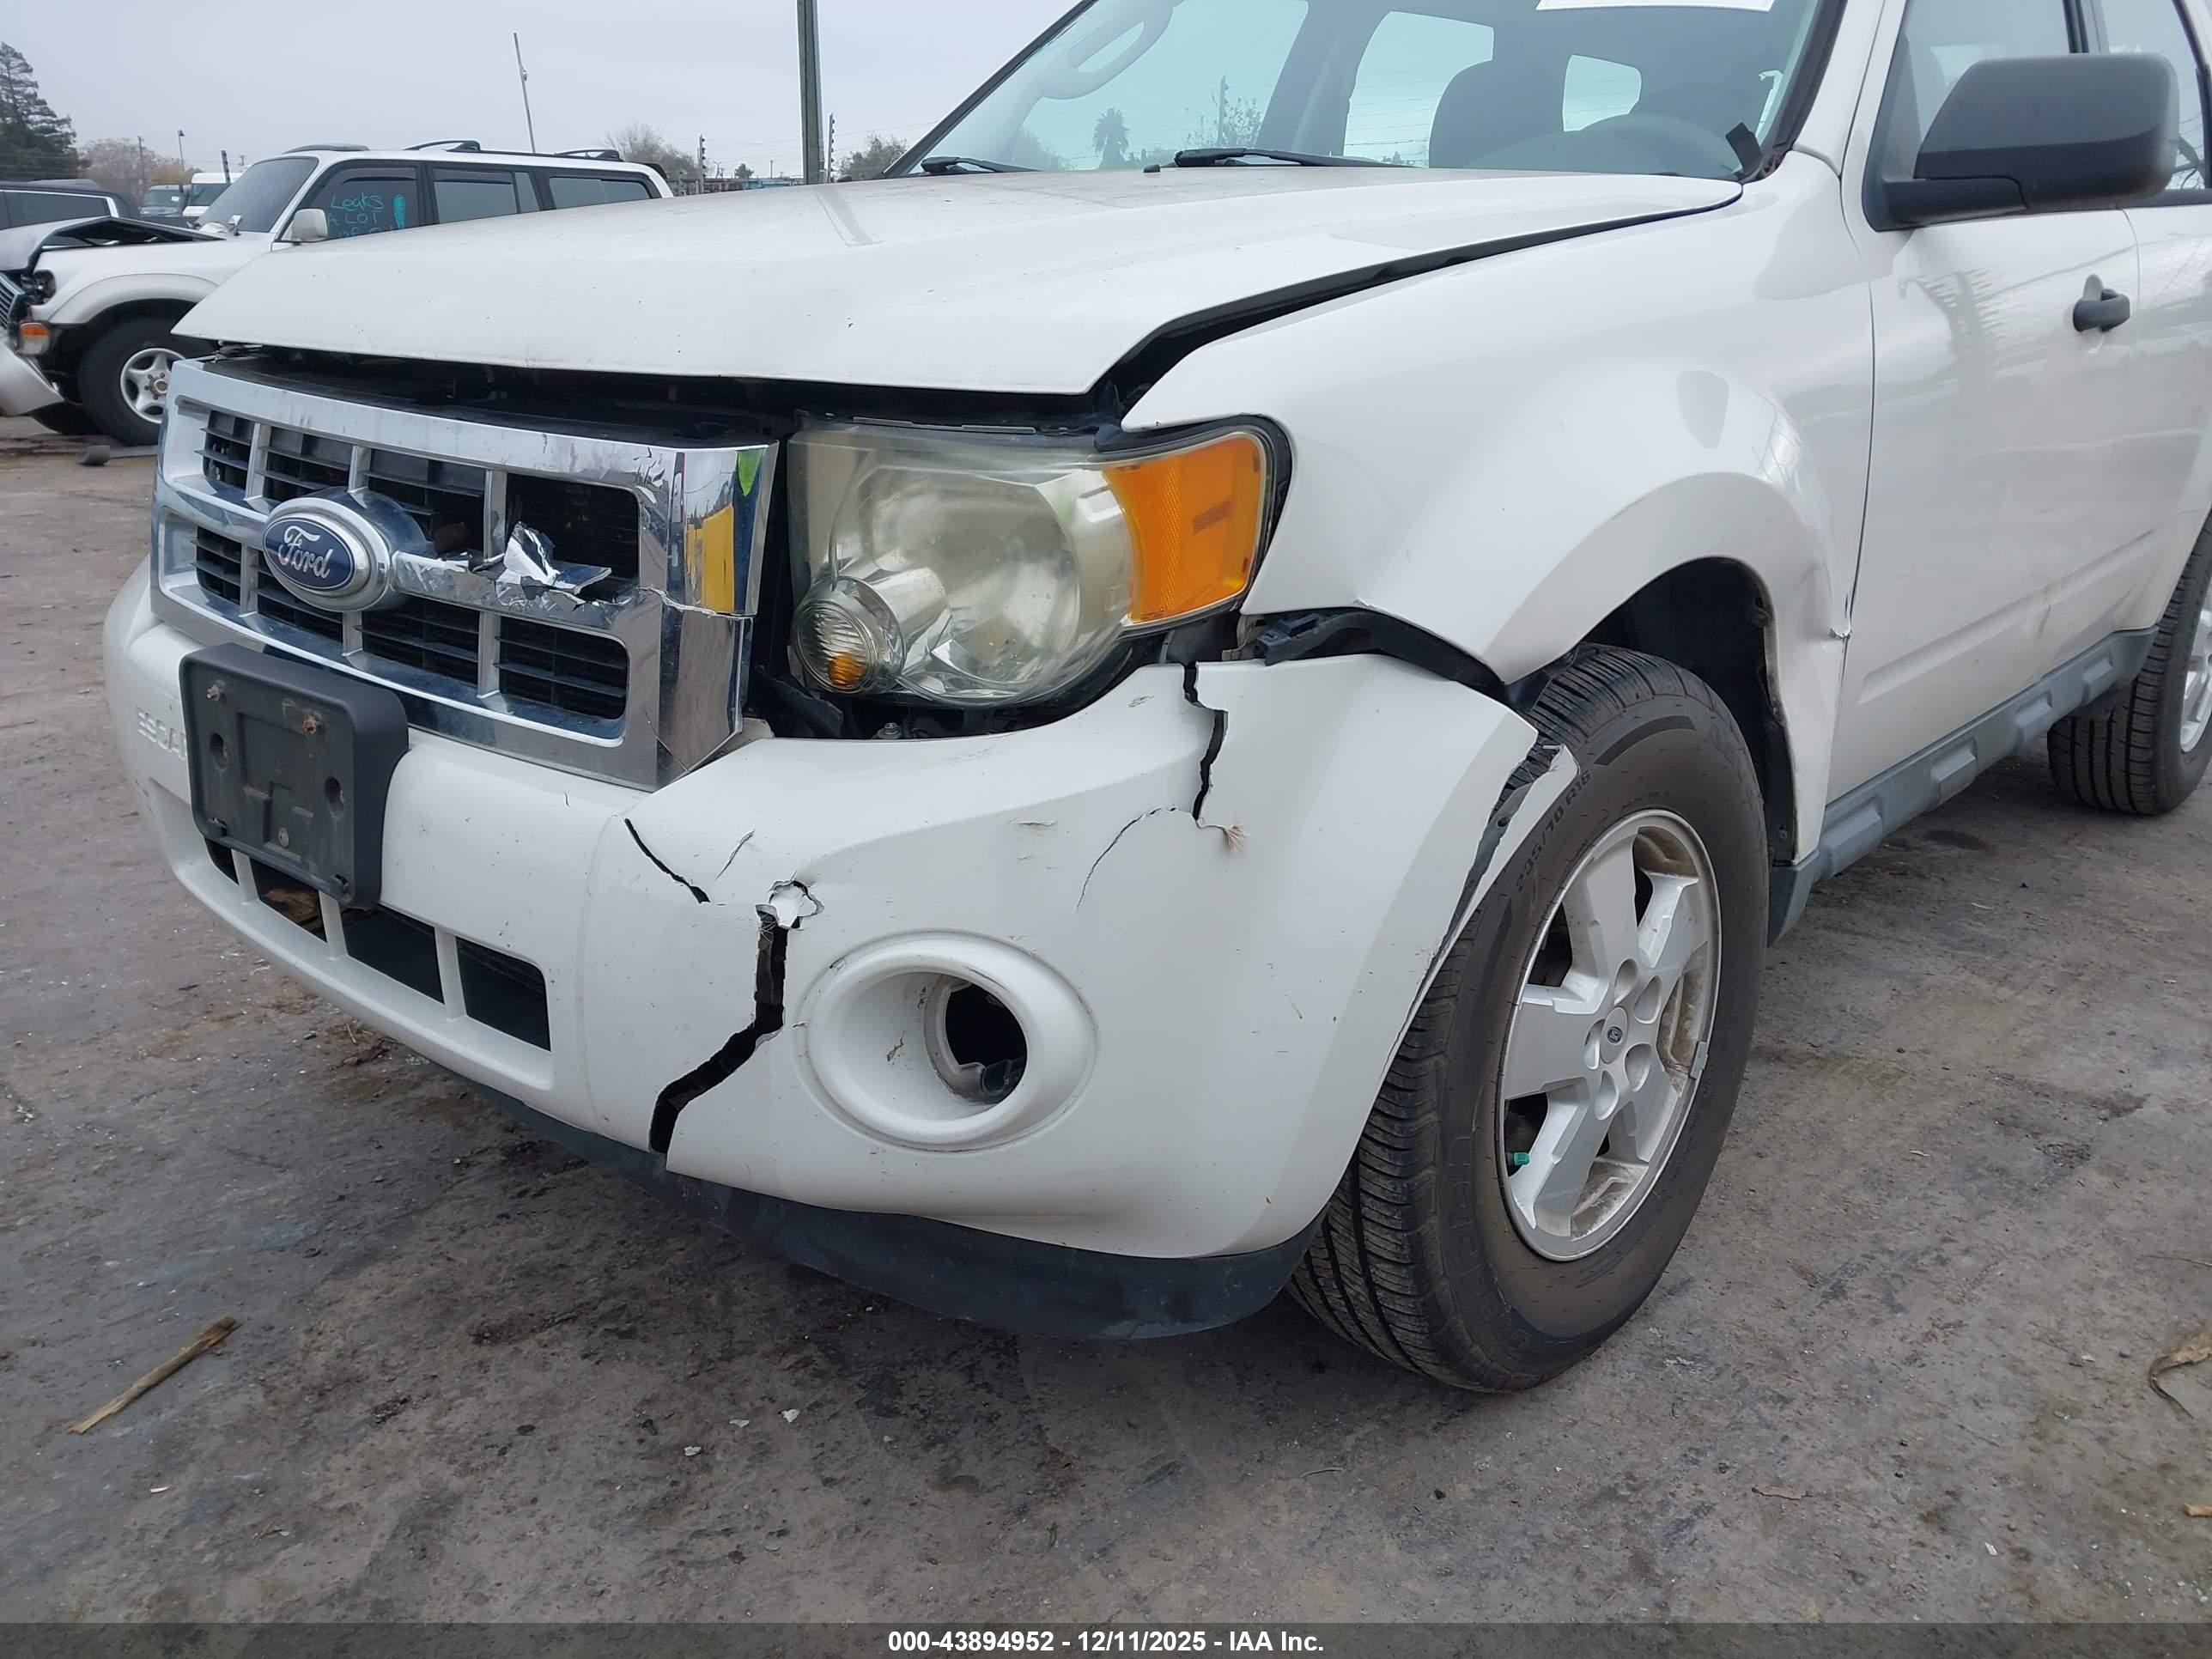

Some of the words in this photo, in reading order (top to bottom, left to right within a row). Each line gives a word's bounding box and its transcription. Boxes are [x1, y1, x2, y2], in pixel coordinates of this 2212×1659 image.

[345, 210, 382, 224] LOT
[278, 526, 333, 579] Ford
[1516, 805, 1564, 892] 235/70
